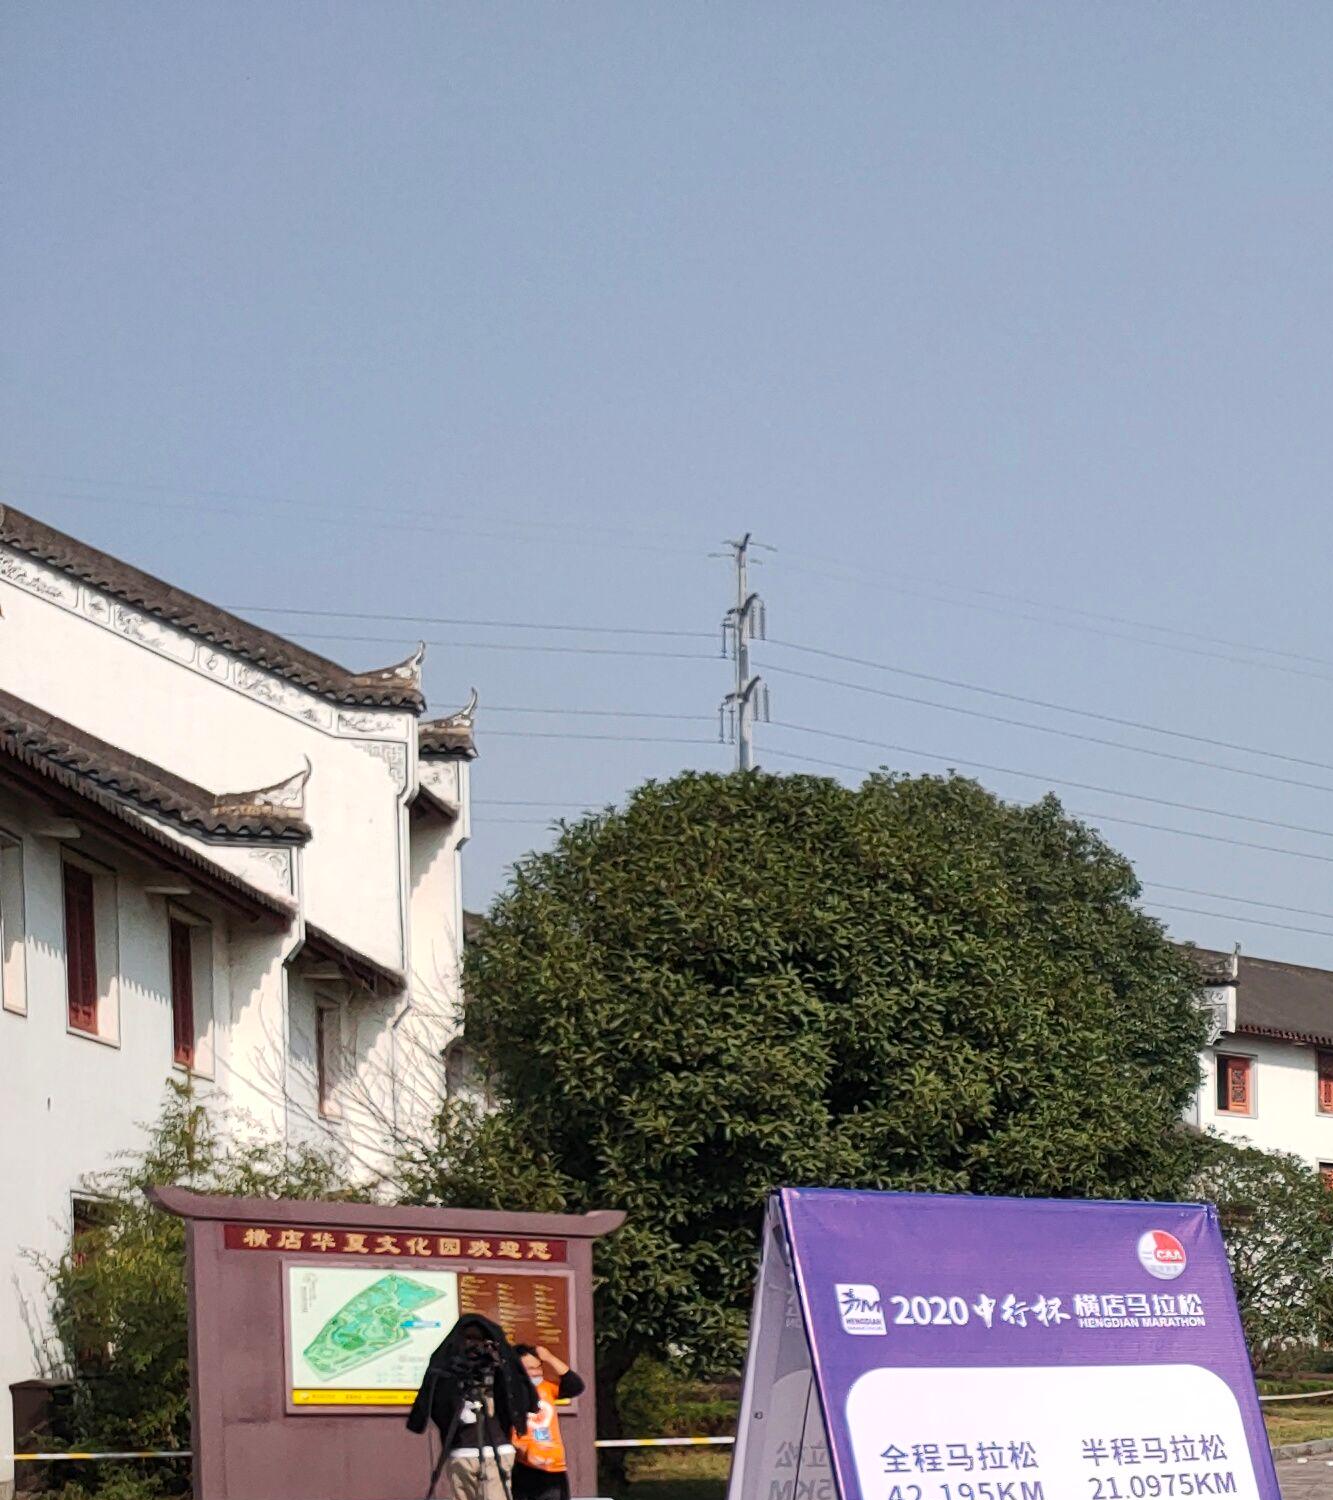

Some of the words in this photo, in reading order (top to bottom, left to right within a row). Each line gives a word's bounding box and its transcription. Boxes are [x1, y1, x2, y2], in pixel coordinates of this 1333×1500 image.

[243, 1228, 553, 1260] 横店华夏文化园欢迎您
[890, 1295, 968, 1326] 2020
[972, 1292, 1072, 1329] 中行杯
[1074, 1292, 1205, 1318] 横店马拉松
[1079, 1317, 1138, 1329] HENGDIAN
[1142, 1316, 1206, 1328] MARATHON
[880, 1441, 1039, 1476] 全程马拉松
[1081, 1434, 1229, 1468] 半程马拉松
